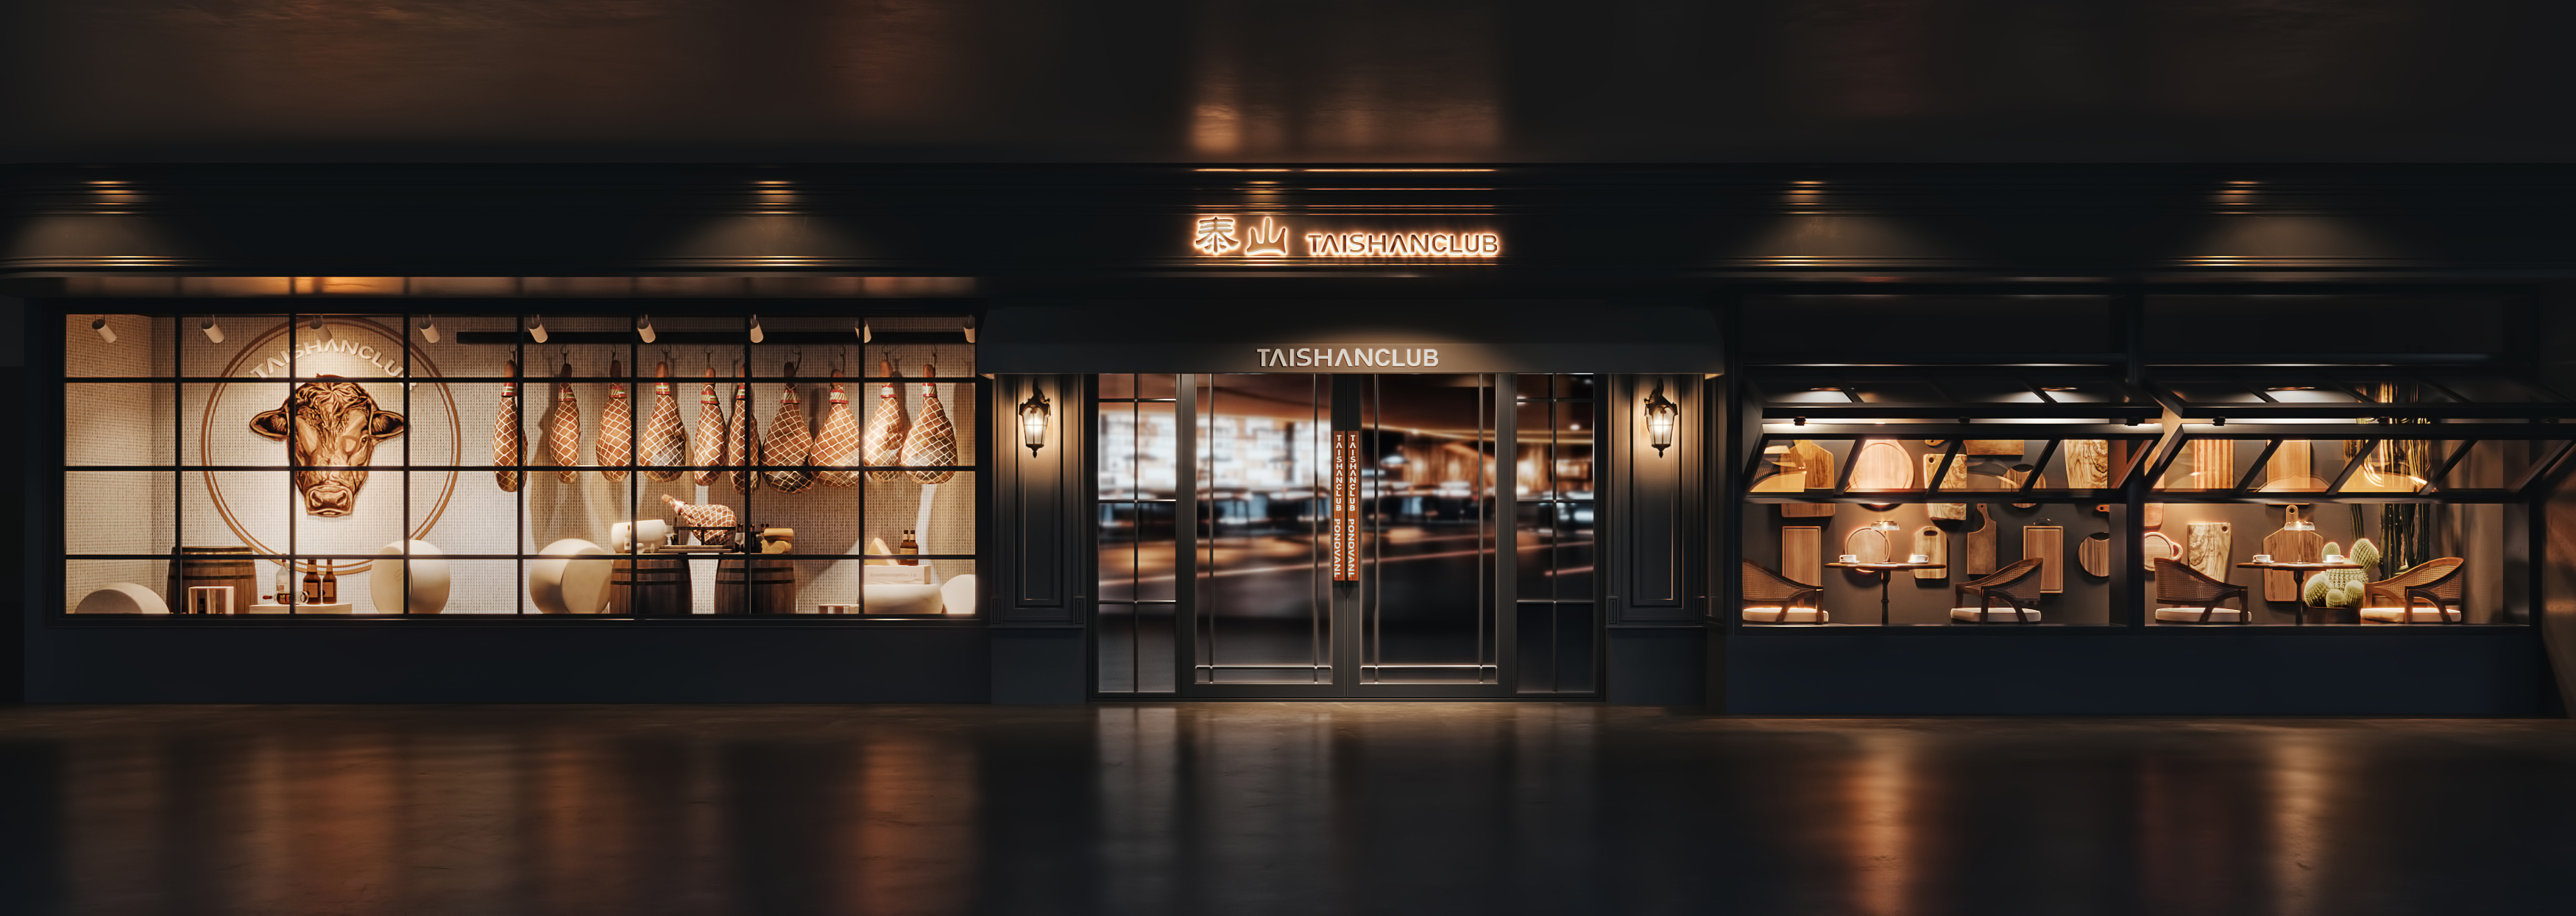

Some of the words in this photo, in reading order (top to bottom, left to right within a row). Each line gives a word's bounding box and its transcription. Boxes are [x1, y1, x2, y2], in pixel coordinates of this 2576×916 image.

[1195, 217, 1287, 253] 泰山
[1307, 234, 1498, 254] TAISHANCLUB
[250, 338, 417, 391] TAISHANCLU
[1256, 348, 1439, 367] TAISHANCLUB
